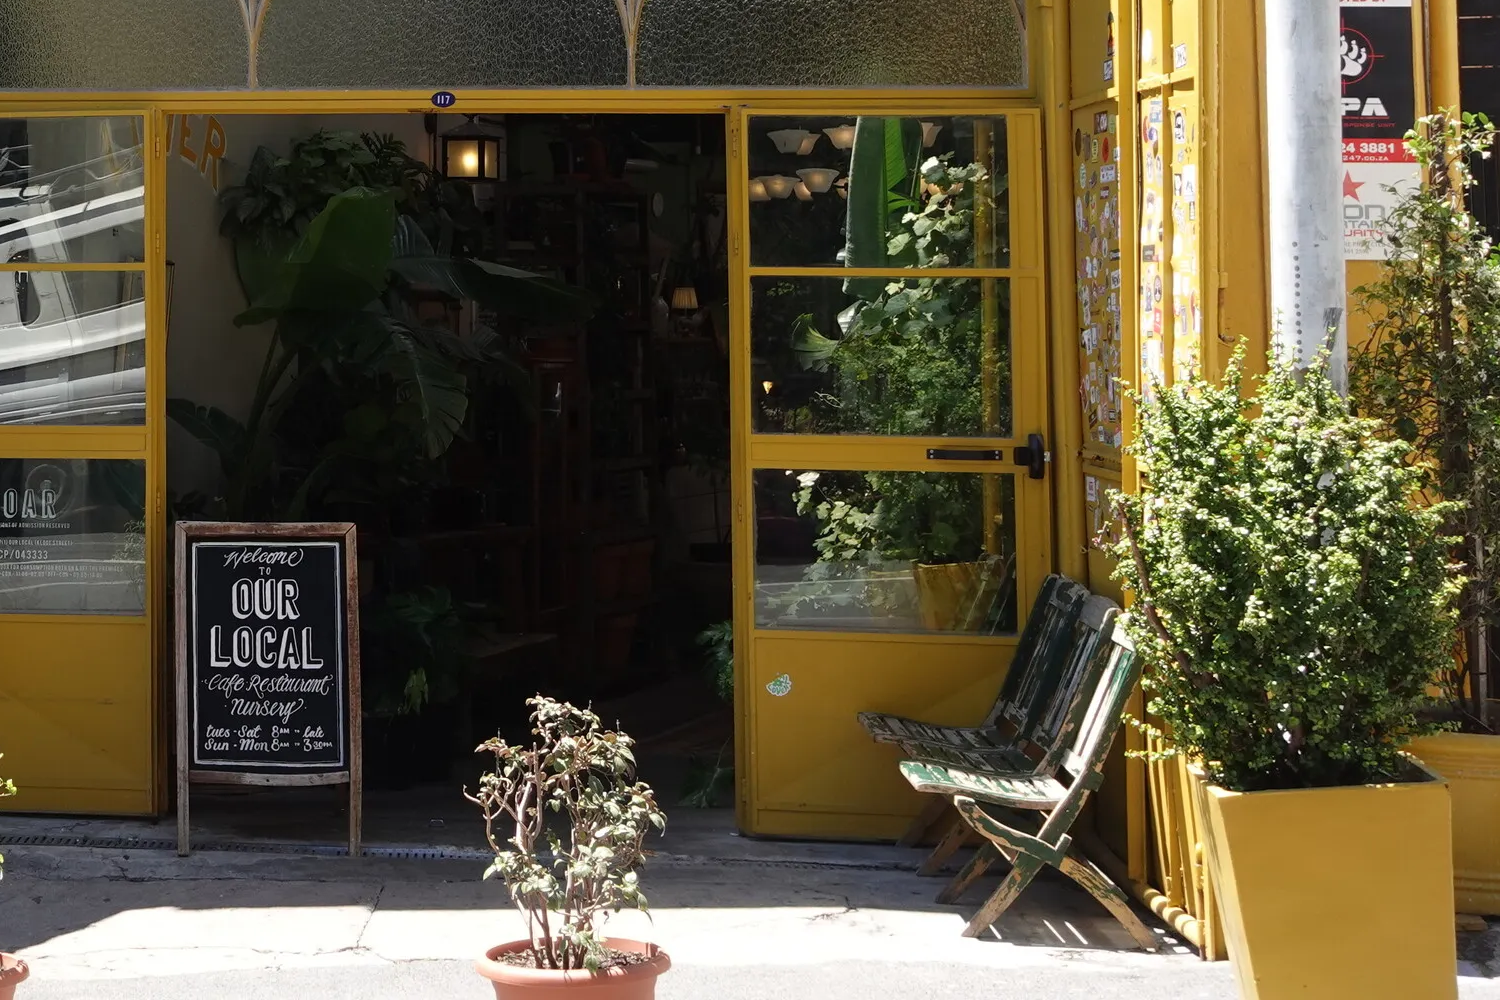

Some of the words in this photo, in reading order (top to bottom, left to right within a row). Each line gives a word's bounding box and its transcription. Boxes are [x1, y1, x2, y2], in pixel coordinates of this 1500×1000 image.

[437, 95, 450, 104] 117
[1341, 97, 1388, 116] PA
[1341, 143, 1356, 153] 24
[1360, 143, 1395, 153] 3881
[223, 547, 304, 569] Welcome
[258, 566, 271, 575] TO
[232, 578, 300, 620] OUR
[210, 625, 324, 669] LOCAL
[205, 674, 245, 699] Cafe
[246, 673, 333, 699] Restaurant
[303, 725, 324, 738] late
[204, 738, 230, 751] Sun
[239, 738, 270, 752] Mon
